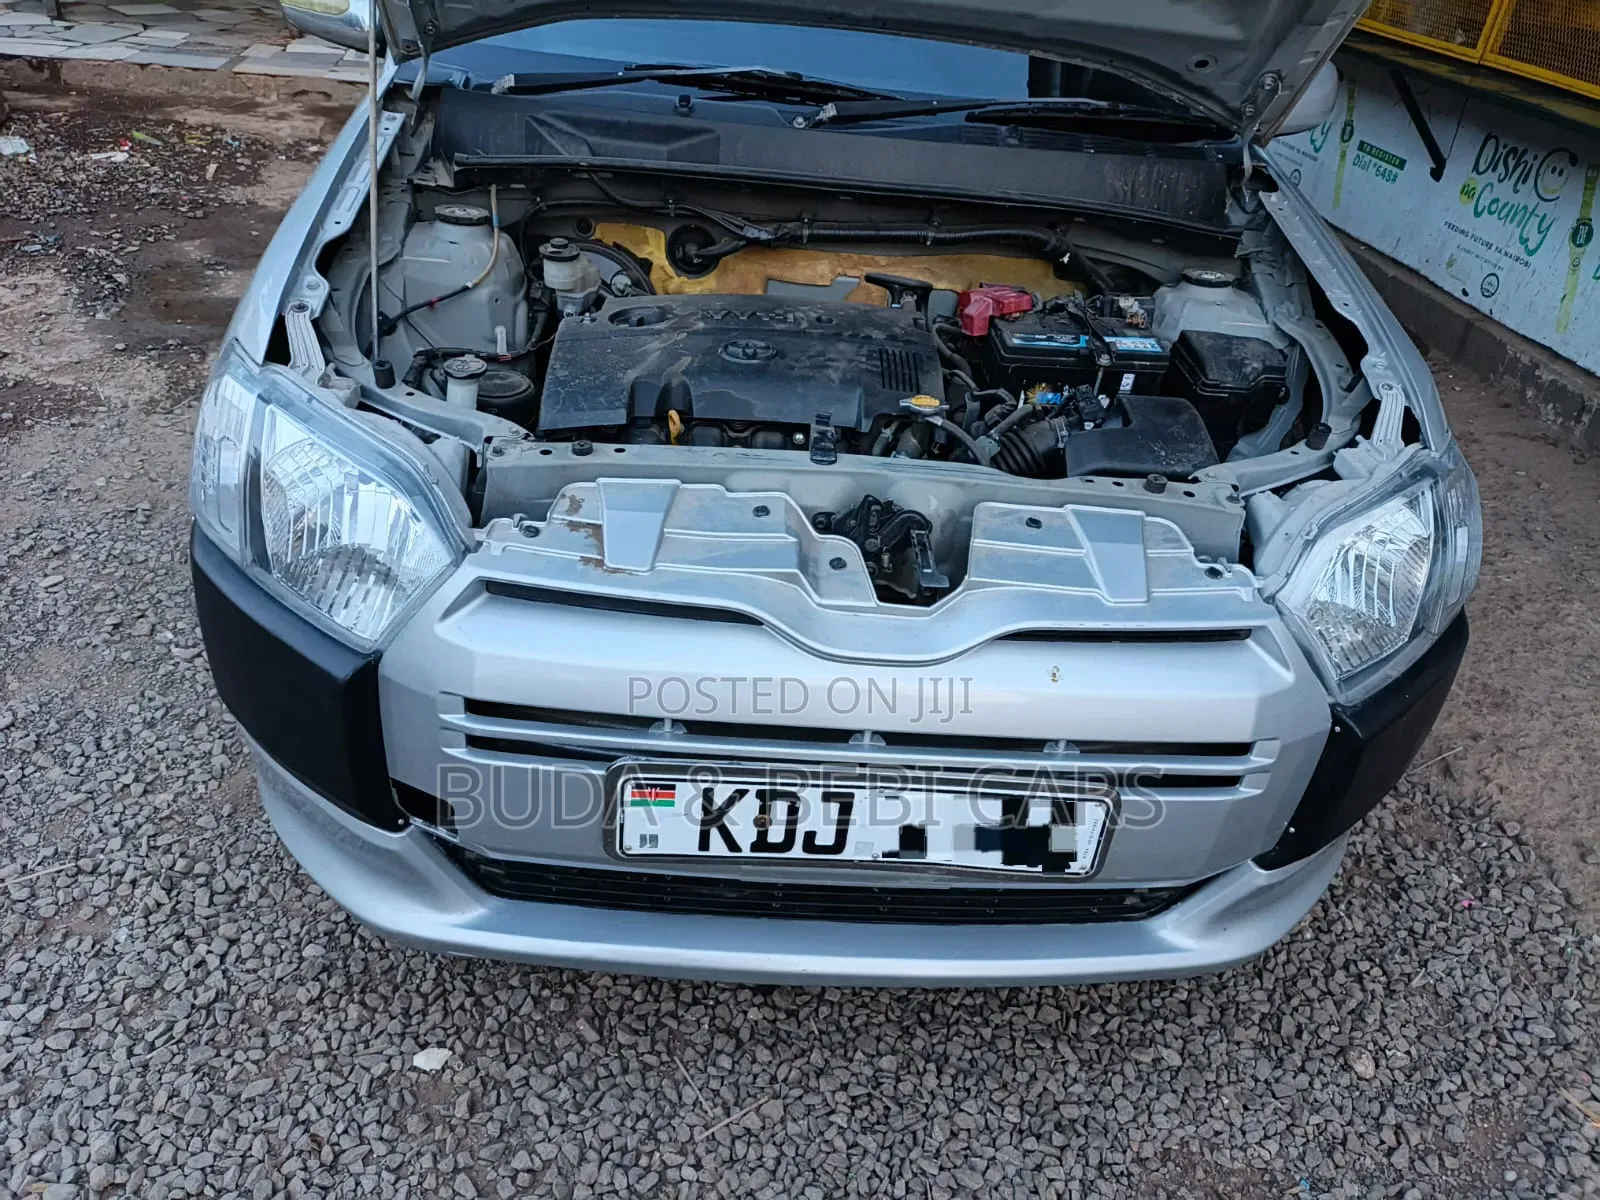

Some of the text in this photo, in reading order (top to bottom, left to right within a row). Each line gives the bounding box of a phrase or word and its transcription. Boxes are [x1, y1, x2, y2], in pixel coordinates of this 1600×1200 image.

[1353, 153, 1371, 171] Dial
[1472, 131, 1538, 193] Dishi
[1444, 221, 1532, 268] FEEDING FUTURE YA NAIROBI
[1460, 183, 1476, 199] na
[1474, 182, 1556, 257] County
[698, 787, 855, 855] KDJ
